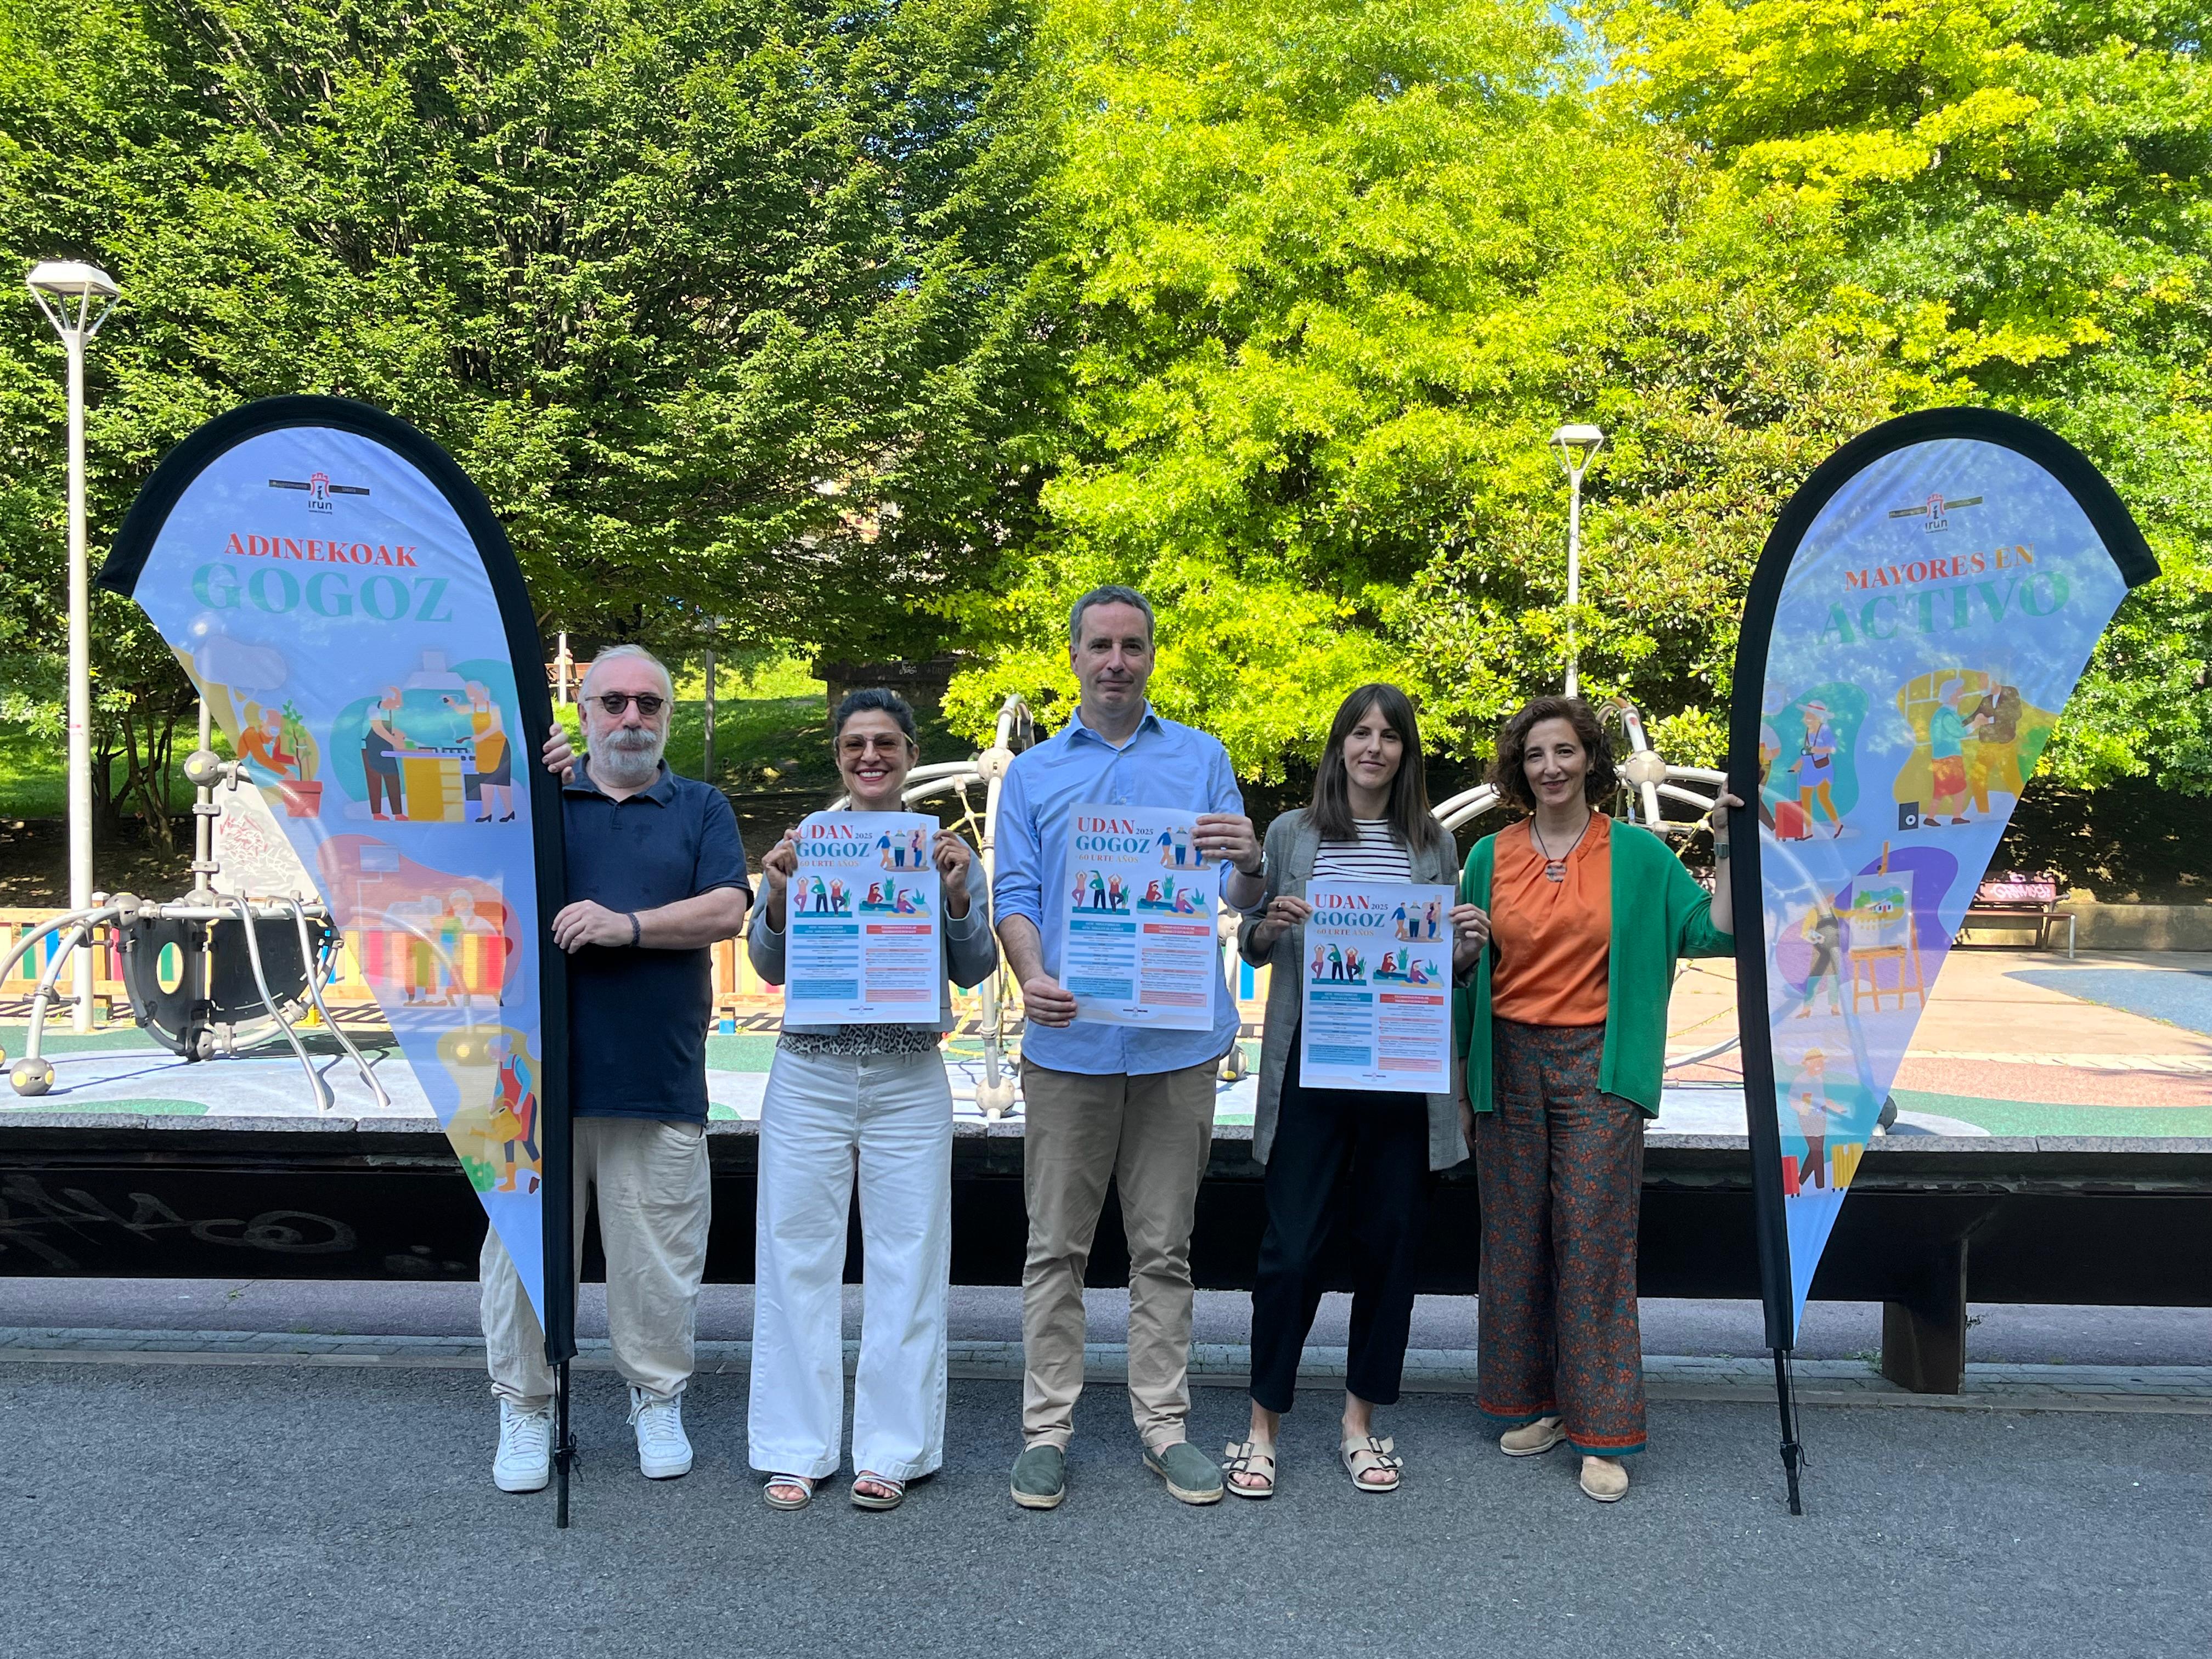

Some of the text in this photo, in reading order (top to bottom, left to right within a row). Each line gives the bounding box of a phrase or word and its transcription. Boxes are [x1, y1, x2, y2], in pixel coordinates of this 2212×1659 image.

[224, 533, 419, 567] ADINEKOAK
[1844, 543, 2035, 591] MAYORES EN
[191, 562, 453, 623] GOGOZ
[1816, 570, 2070, 646] ACTIVO
[798, 825, 854, 839] UDAN
[1078, 817, 1135, 834] UDAN
[796, 842, 870, 857] GOGOZ
[1076, 836, 1150, 854] GOGOZ
[1116, 855, 1138, 864] AÑOS
[1314, 894, 1370, 910] UDAN
[1313, 911, 1385, 928] GOGOZ
[1352, 928, 1374, 936] AÑOS
